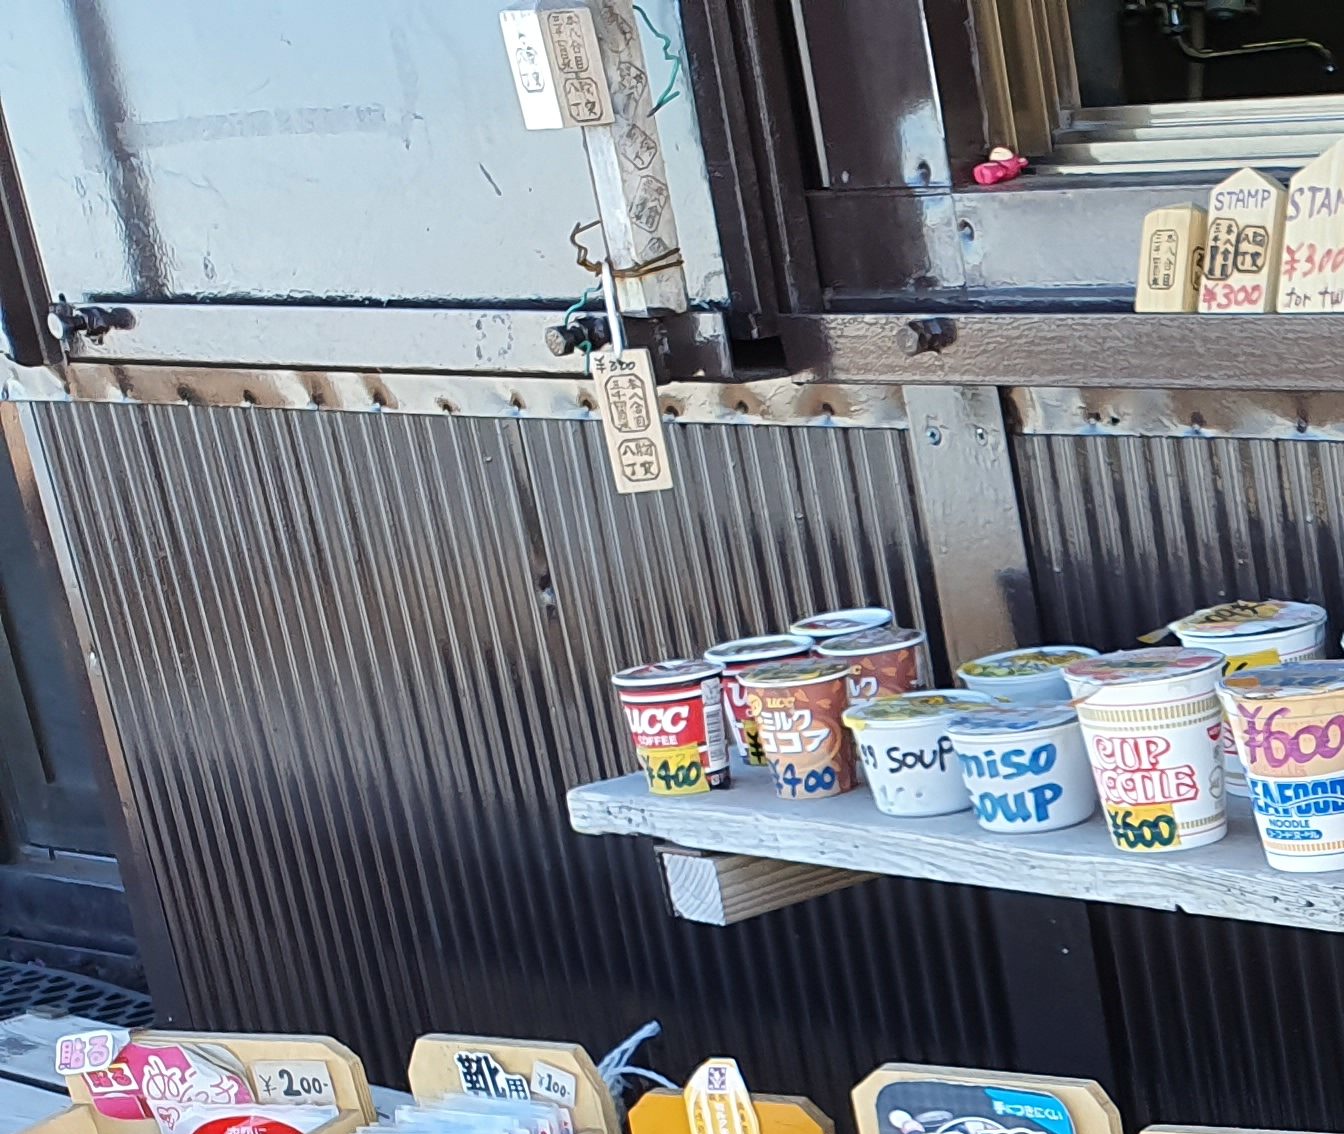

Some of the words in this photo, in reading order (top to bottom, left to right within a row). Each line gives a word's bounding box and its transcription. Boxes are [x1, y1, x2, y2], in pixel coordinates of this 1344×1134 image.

[1215, 188, 1271, 212] STAMP
[1202, 284, 1263, 310] ¥300
[1093, 735, 1171, 771] CUP
[59, 1036, 109, 1071] 貼る
[459, 1053, 529, 1101] 靴用
